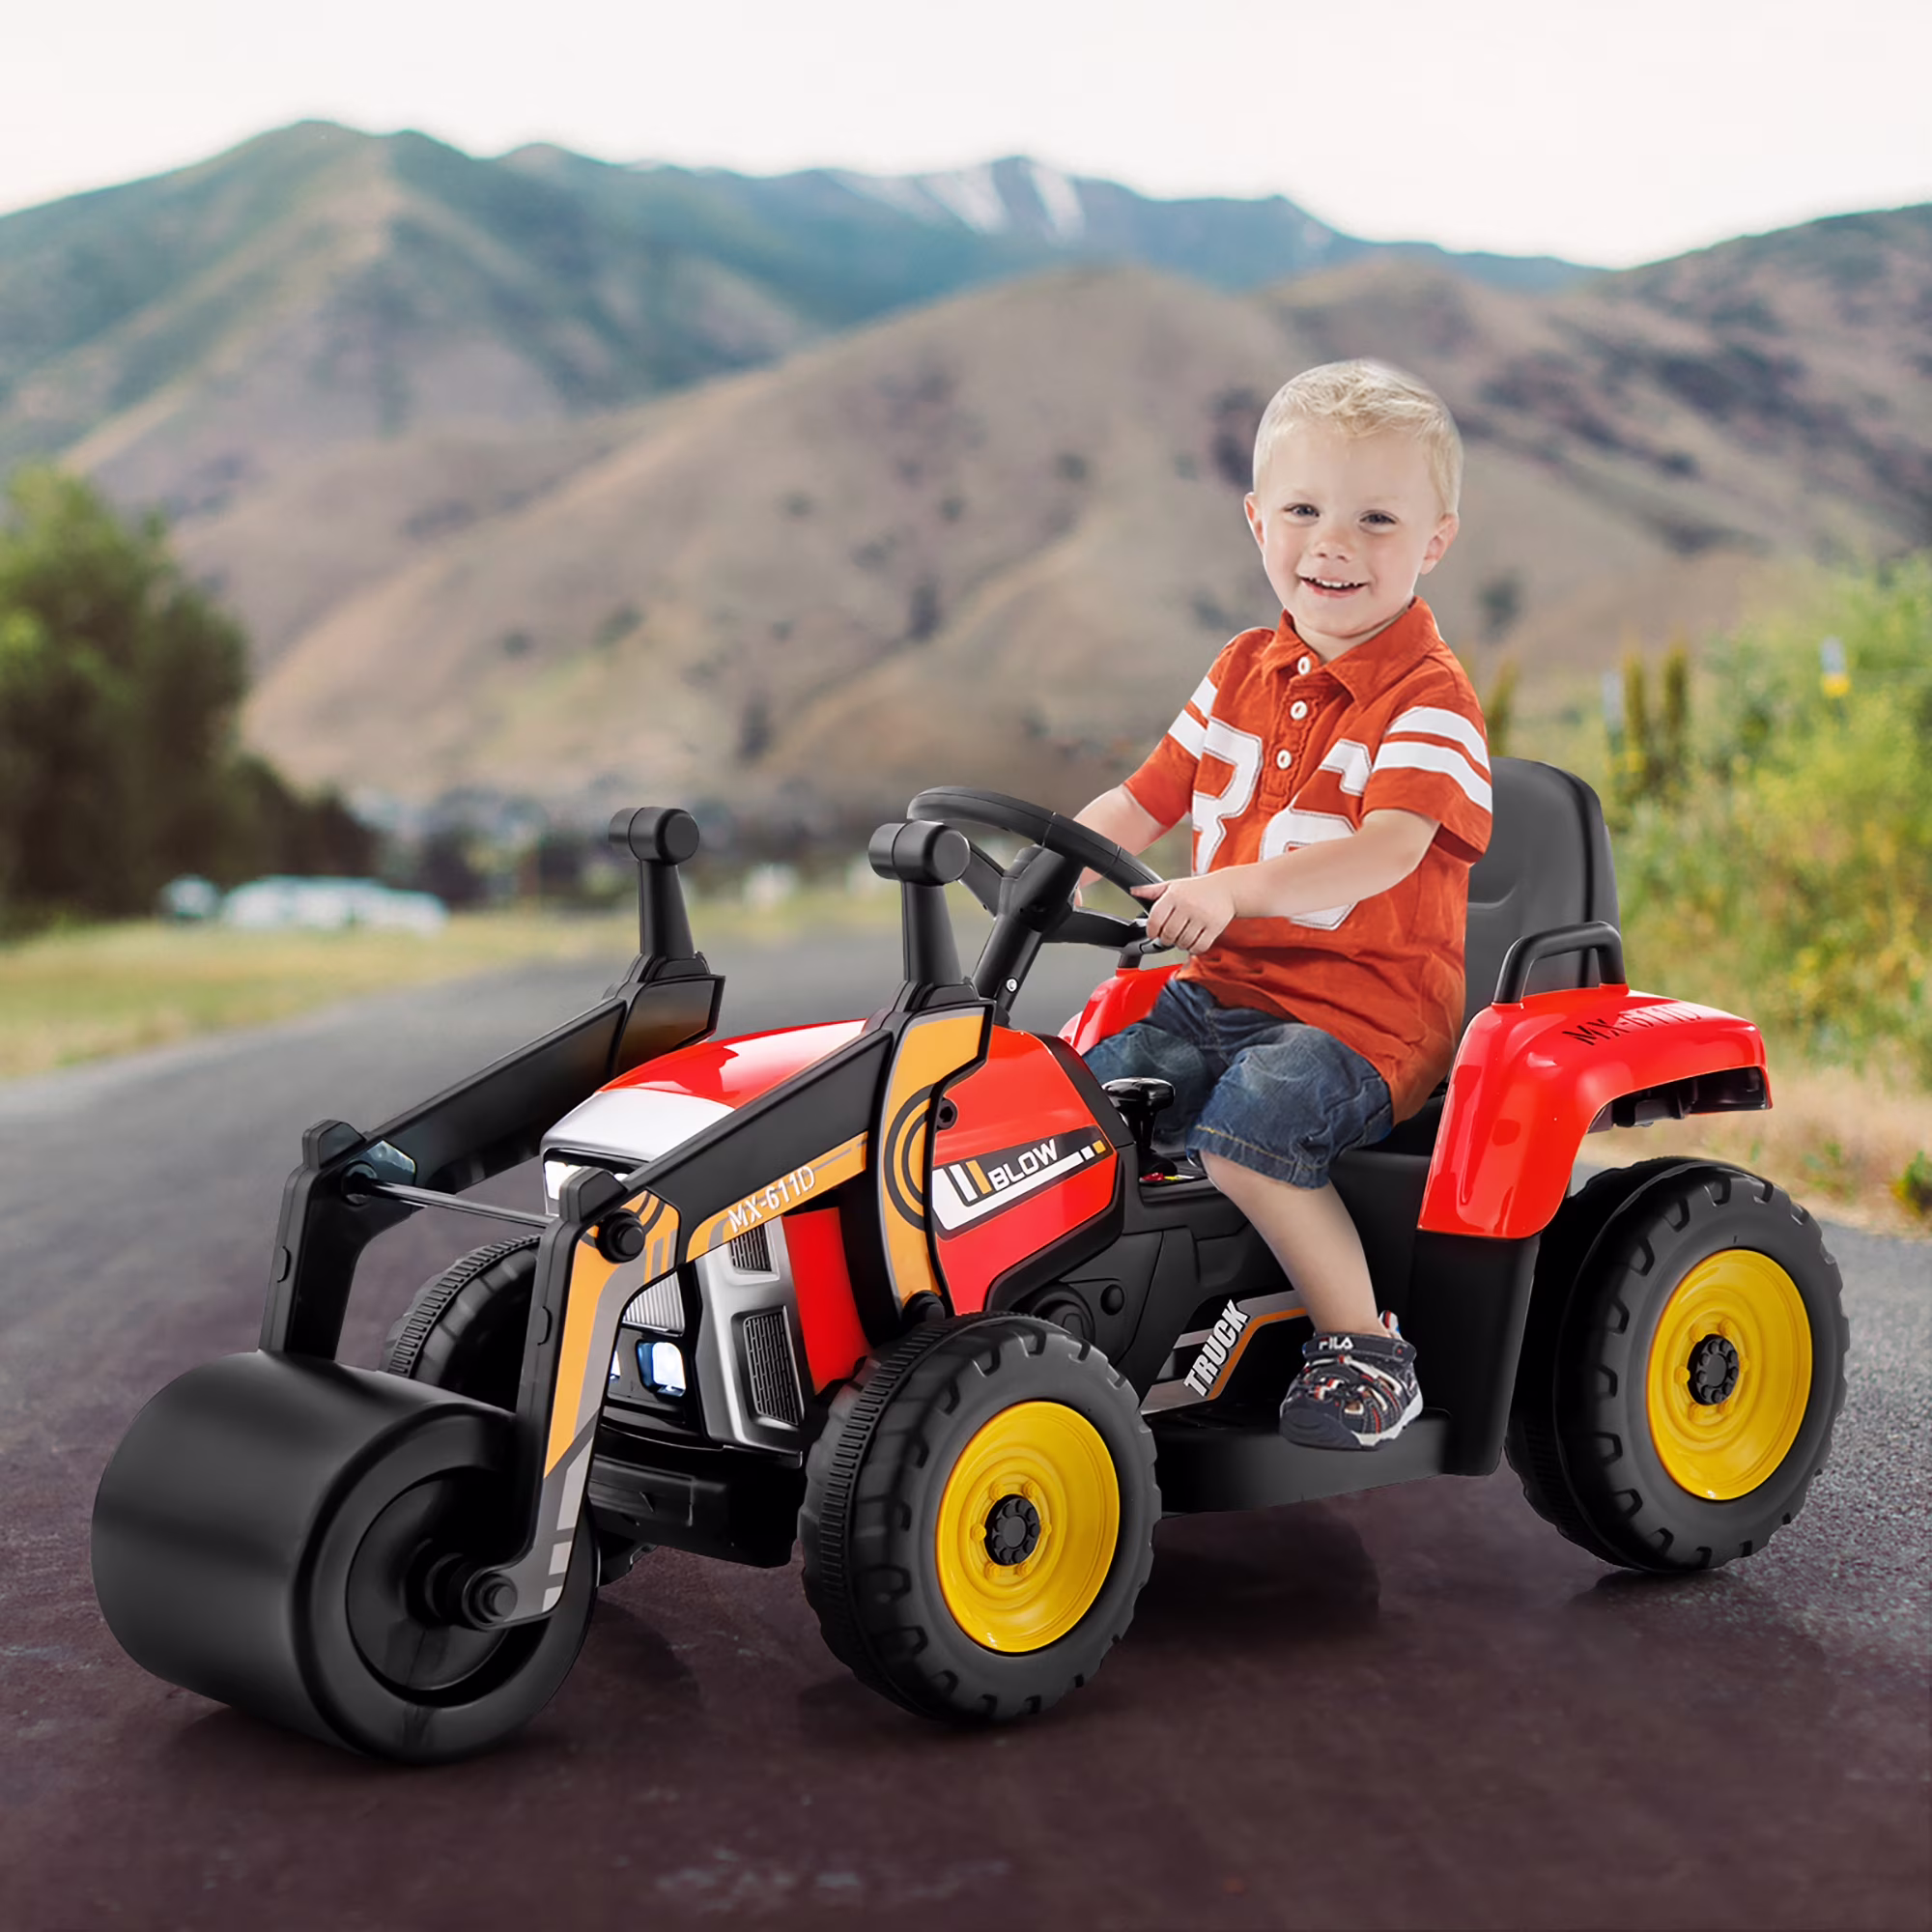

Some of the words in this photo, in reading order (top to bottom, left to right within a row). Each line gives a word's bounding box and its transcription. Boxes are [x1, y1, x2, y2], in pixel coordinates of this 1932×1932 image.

[986, 1138, 1058, 1191] BLOW
[727, 1165, 816, 1234] MX-611D
[1183, 1298, 1249, 1397] TRUCK
[1318, 1336, 1354, 1350] FILA
